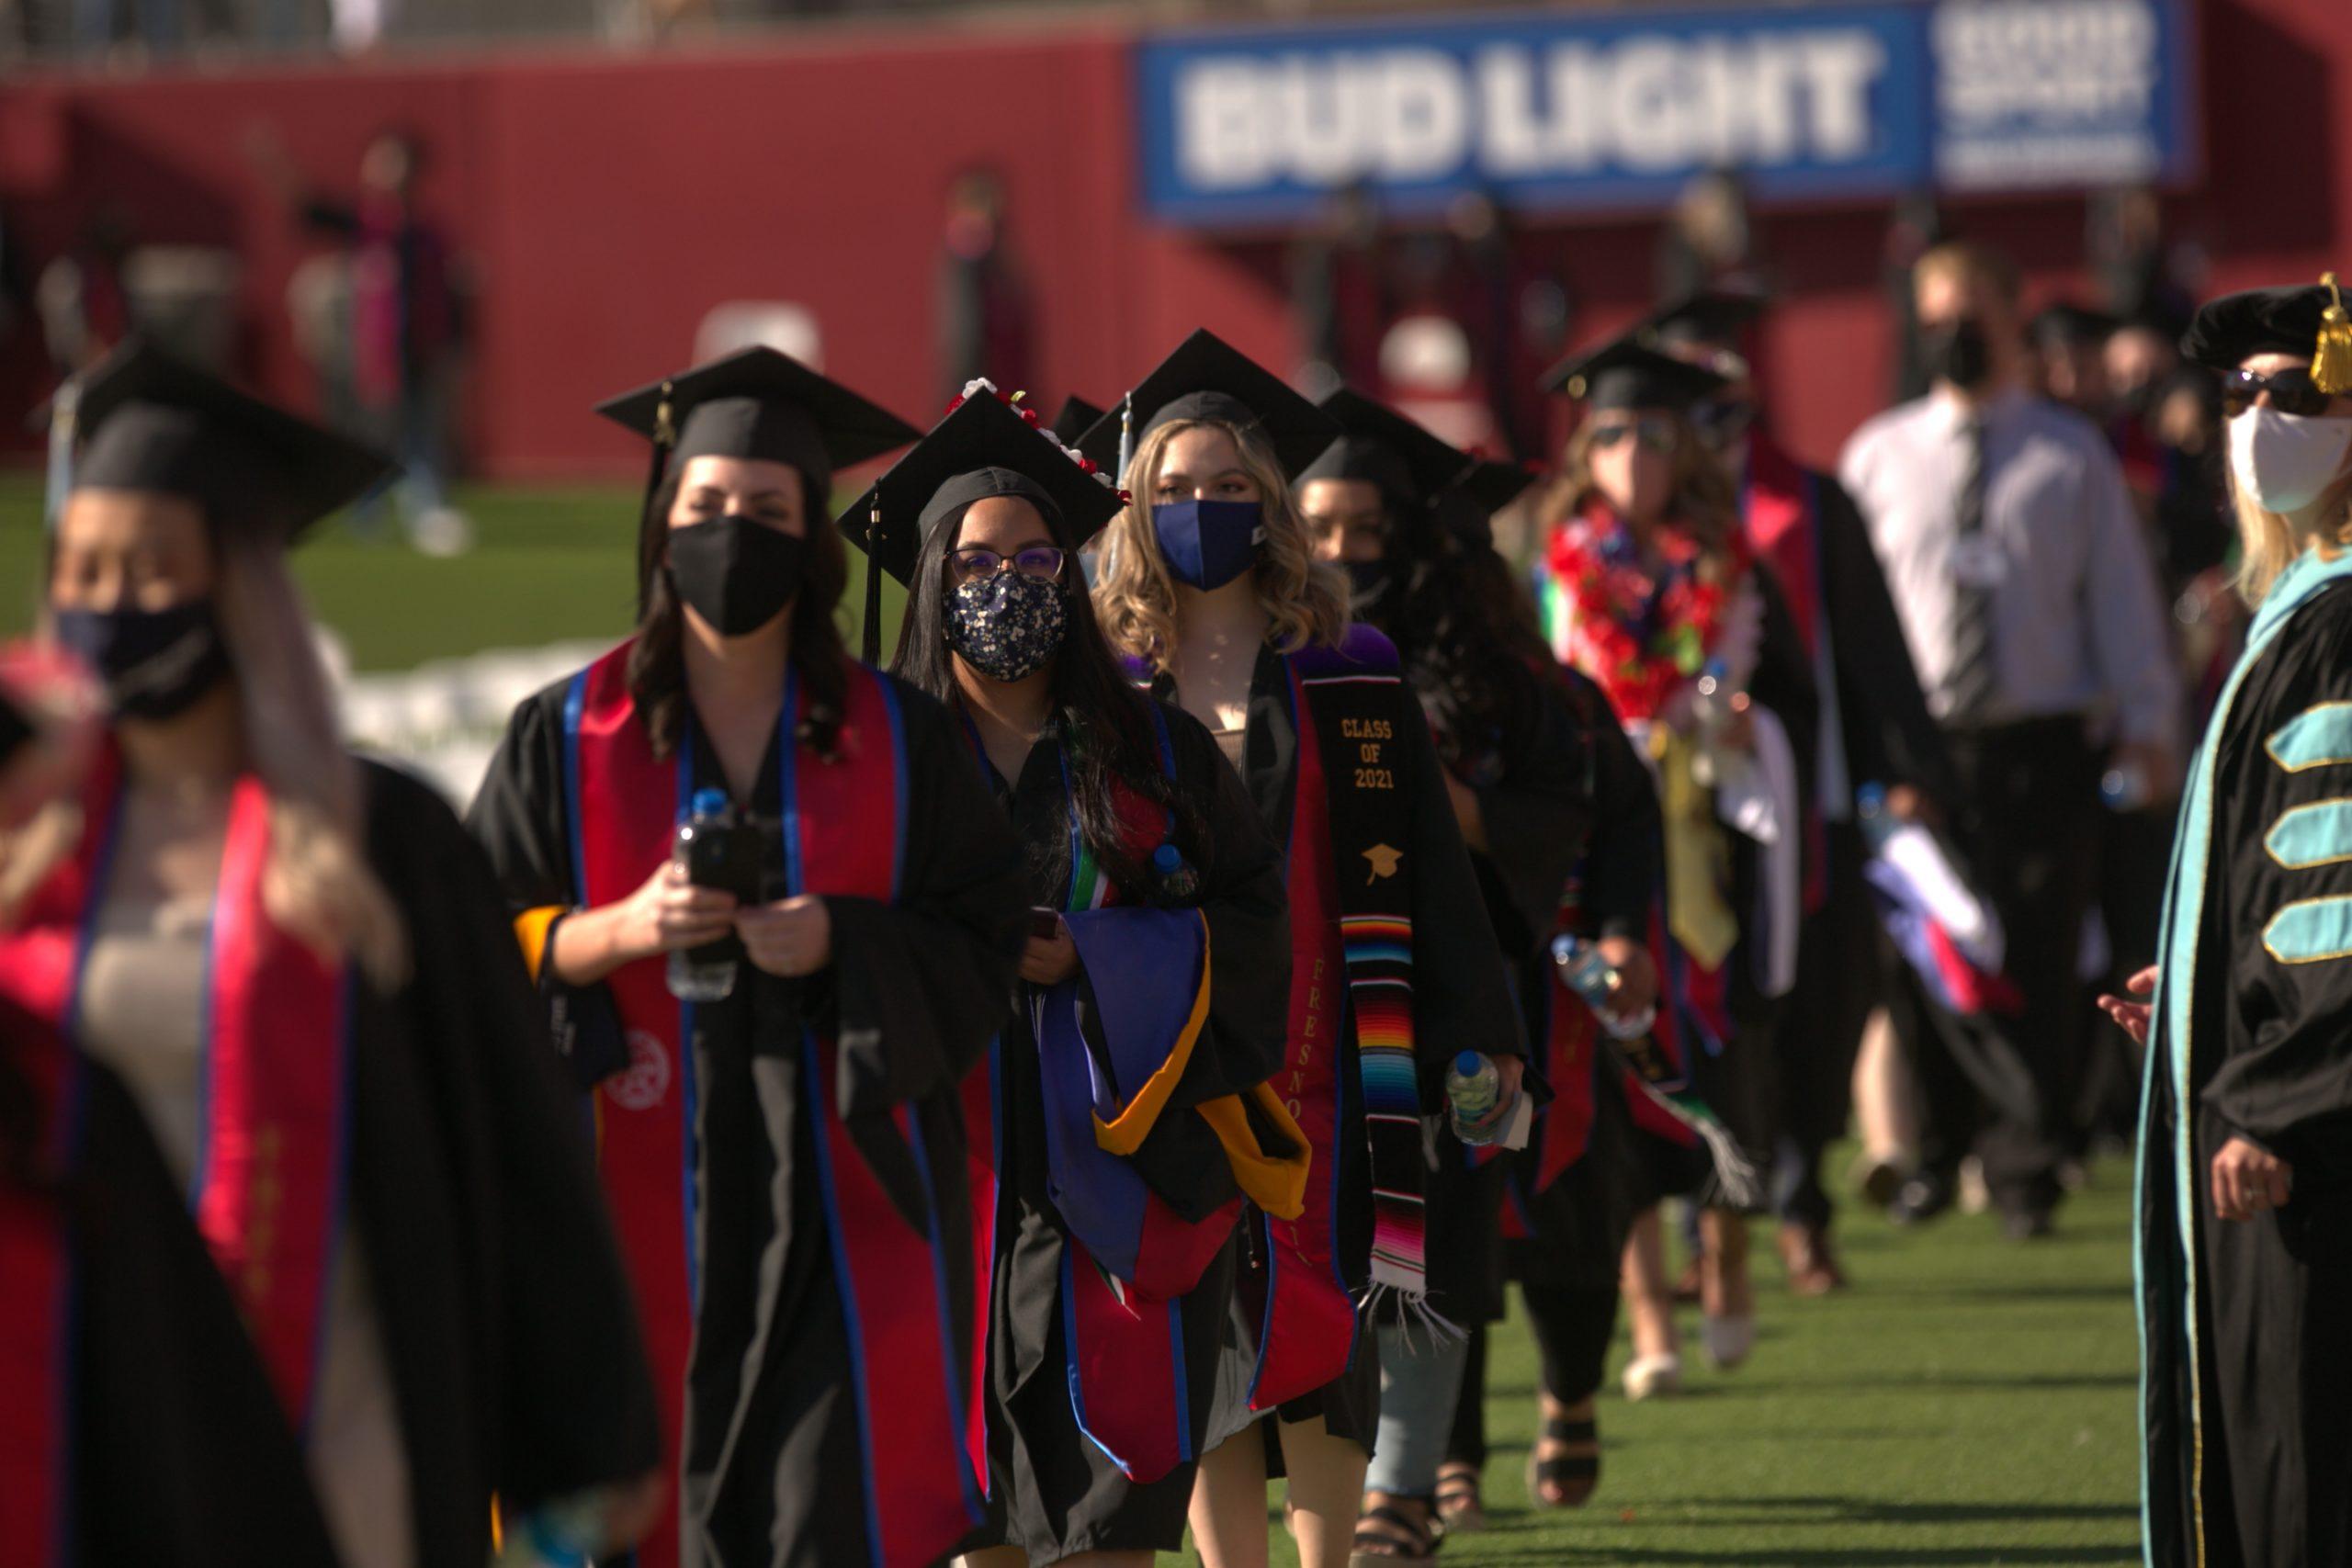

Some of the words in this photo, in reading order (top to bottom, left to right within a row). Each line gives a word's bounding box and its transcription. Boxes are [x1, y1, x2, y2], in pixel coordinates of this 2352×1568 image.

[1181, 58, 1464, 182] BUD
[1481, 33, 1879, 173] LIGHT
[1340, 717, 1393, 739] CLASS
[1360, 743, 1381, 763] OF
[1353, 767, 1395, 789] 2021
[1286, 959, 1324, 1120] FRESNO
